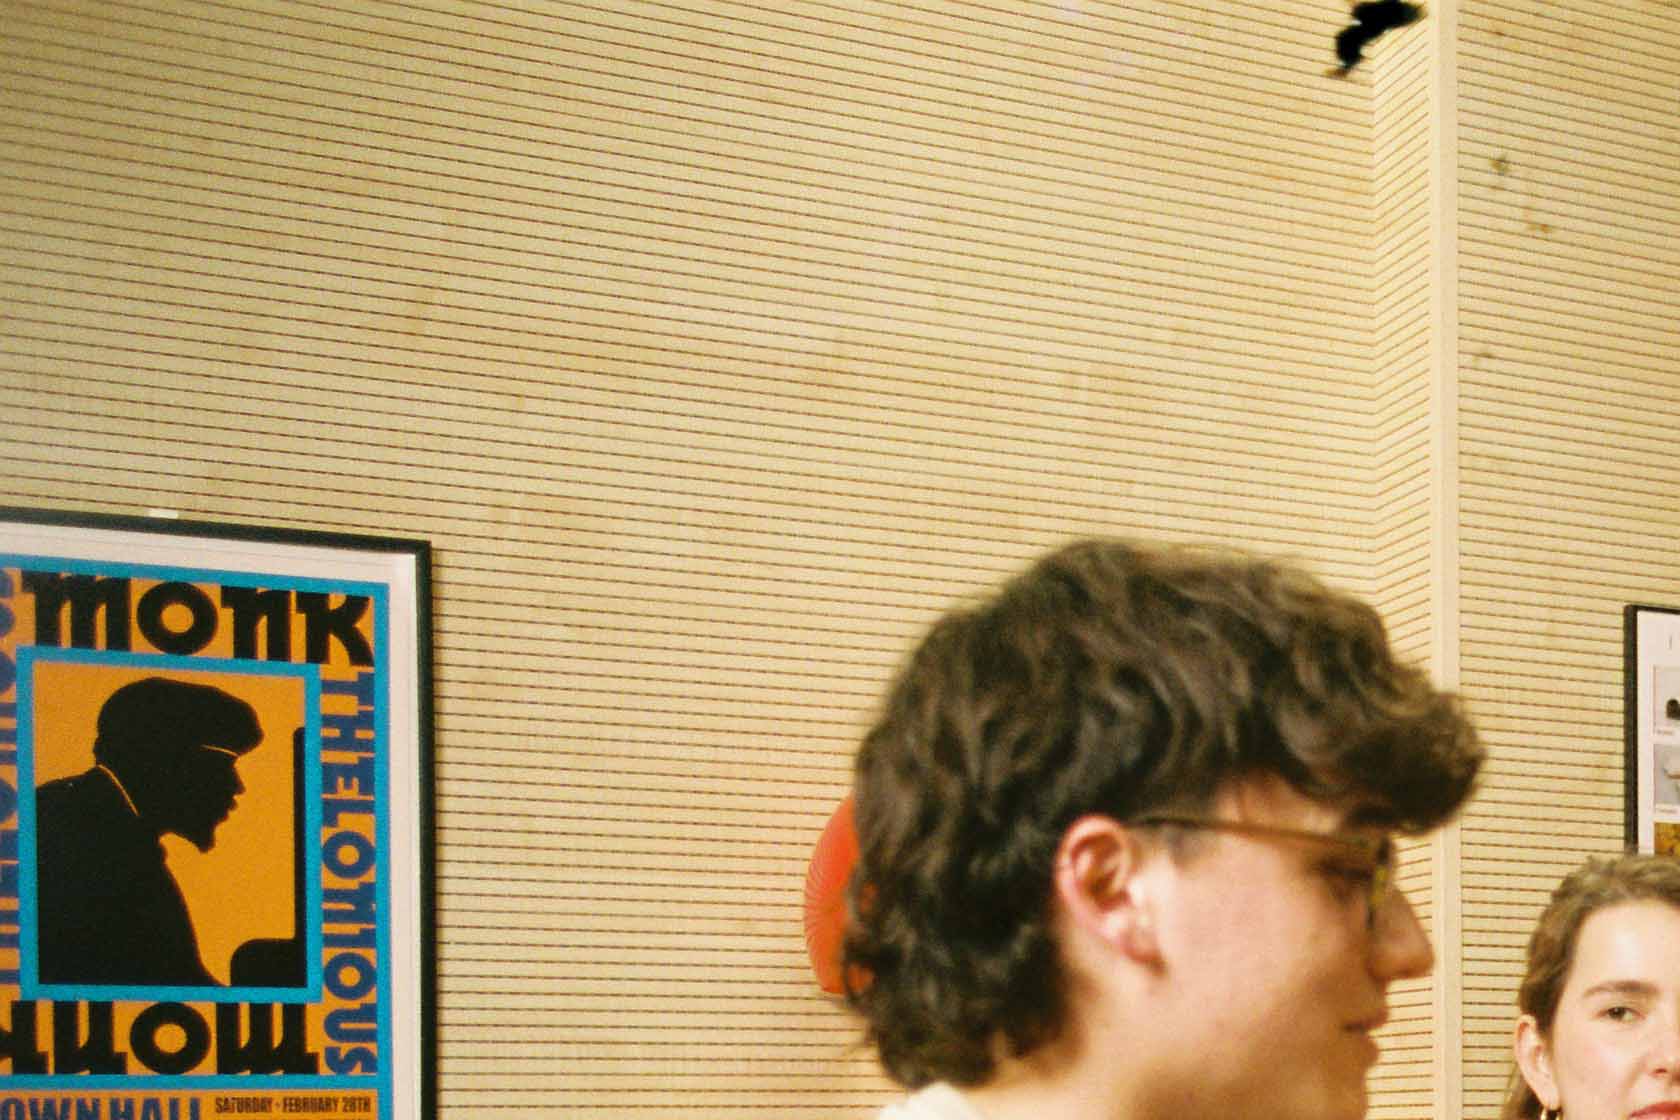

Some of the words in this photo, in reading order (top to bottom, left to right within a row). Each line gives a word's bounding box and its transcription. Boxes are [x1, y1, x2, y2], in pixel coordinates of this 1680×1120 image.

[216, 1097, 273, 1113] SATURDAY
[282, 1097, 338, 1113] FEBRUARY
[342, 1097, 371, 1113] 28TH
